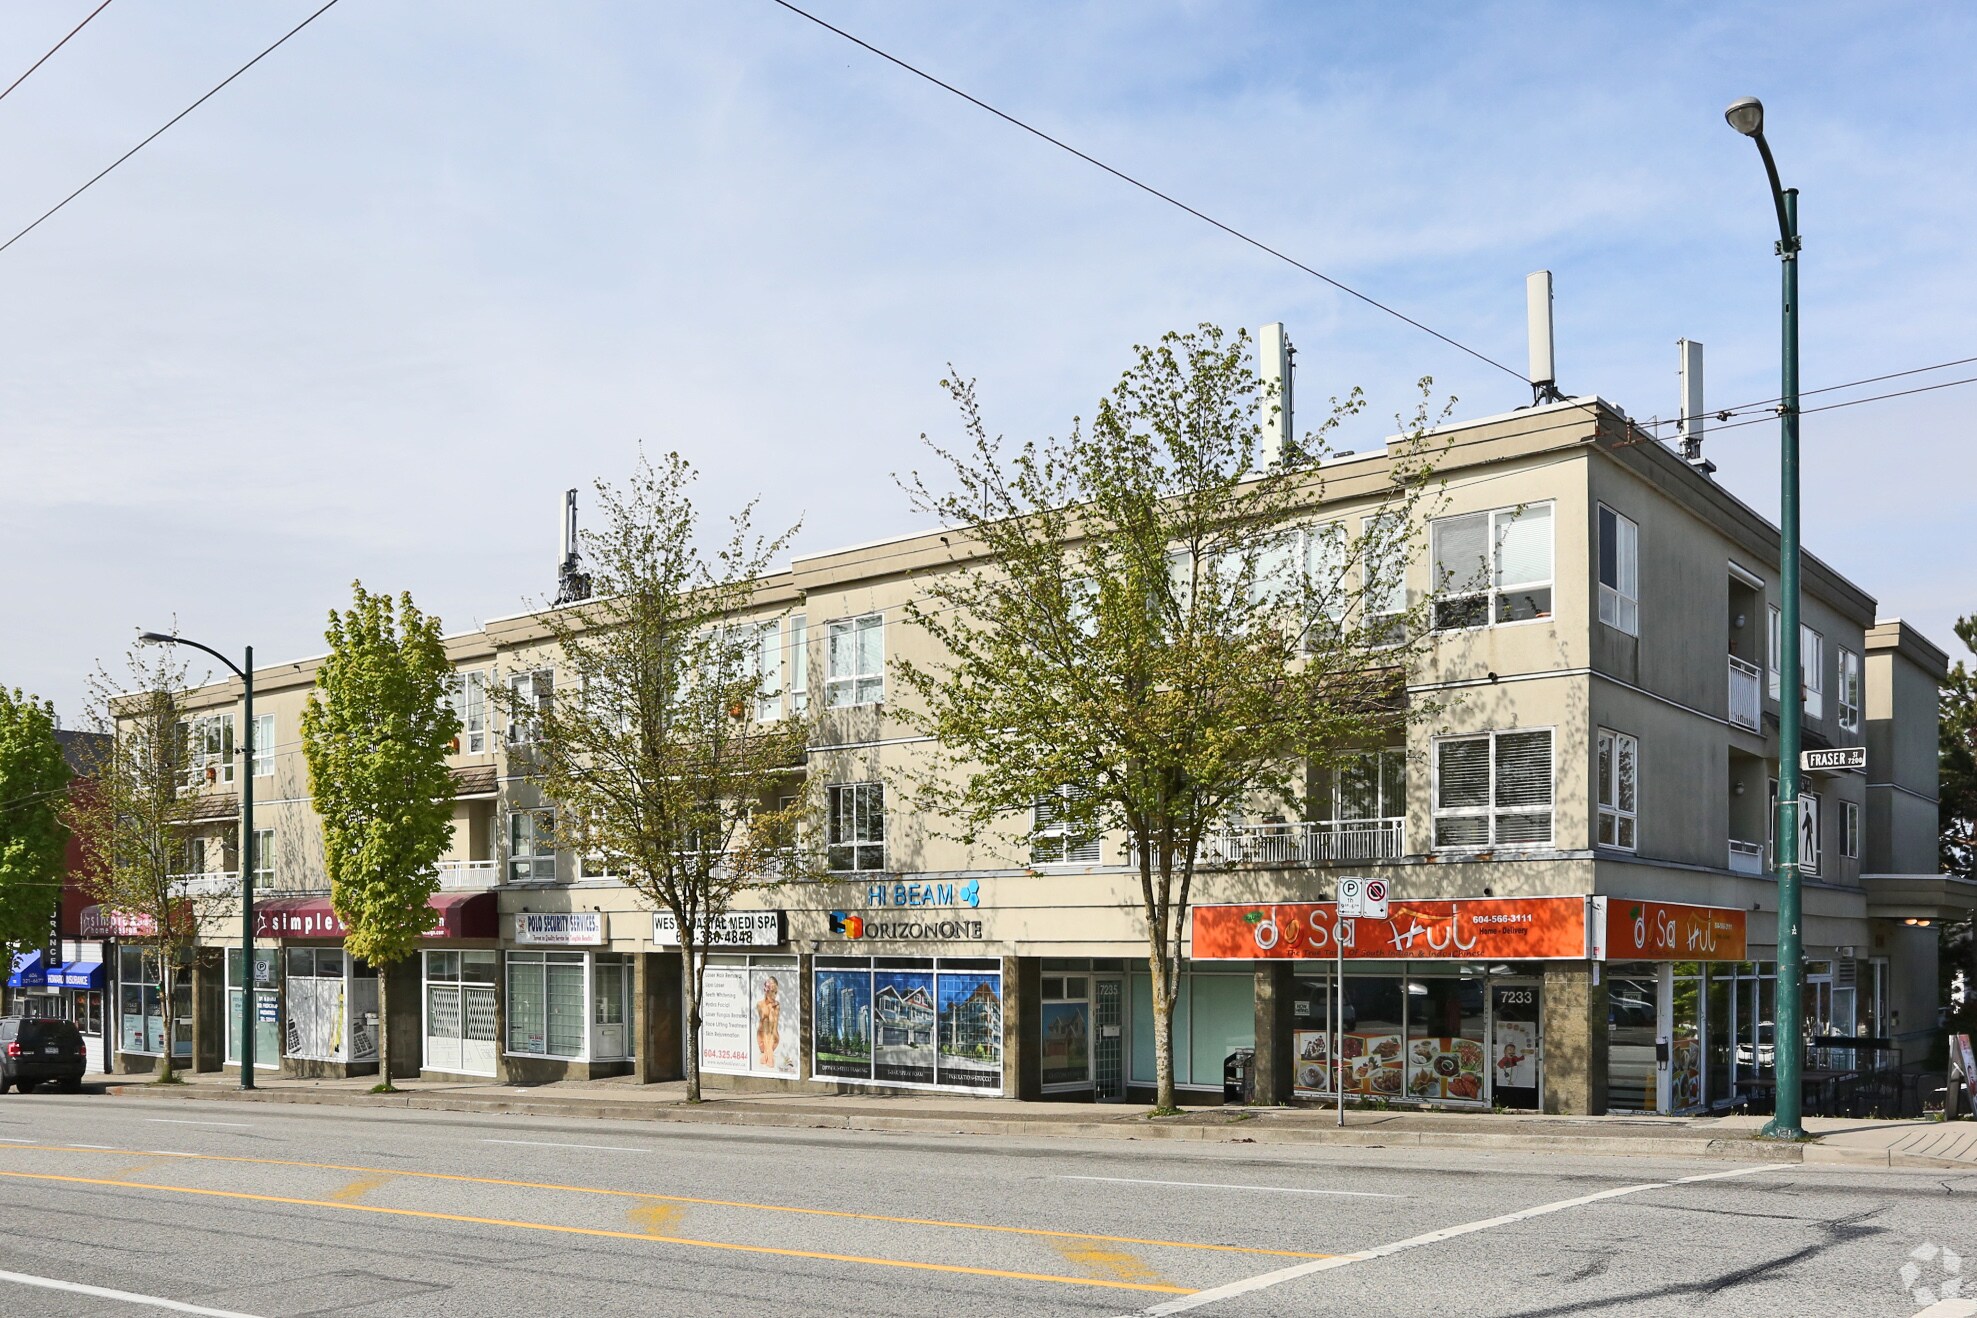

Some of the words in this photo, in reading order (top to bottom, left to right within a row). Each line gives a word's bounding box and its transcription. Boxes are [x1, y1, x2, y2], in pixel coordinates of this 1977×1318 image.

[1810, 752, 1846, 767] FRASER
[1848, 757, 1863, 765] 7200
[868, 885, 886, 906] HI
[894, 883, 953, 906] BEAM
[527, 915, 543, 932] POLO
[544, 915, 569, 932] SECURITY
[570, 915, 596, 932] SERVICES
[730, 917, 754, 930] MEDI
[757, 915, 777, 930] SPA
[1472, 914, 1532, 924] 604-566-3111
[1480, 927, 1497, 935] Home
[1502, 926, 1528, 936] Delivery
[1286, 949, 1300, 957] The
[1304, 949, 1321, 957] True
[1325, 949, 1344, 957] Tas
[1362, 949, 1384, 957] South
[1388, 949, 1414, 957] Indian
[1099, 984, 1118, 995] 7235
[1501, 991, 1532, 1004] 7233
